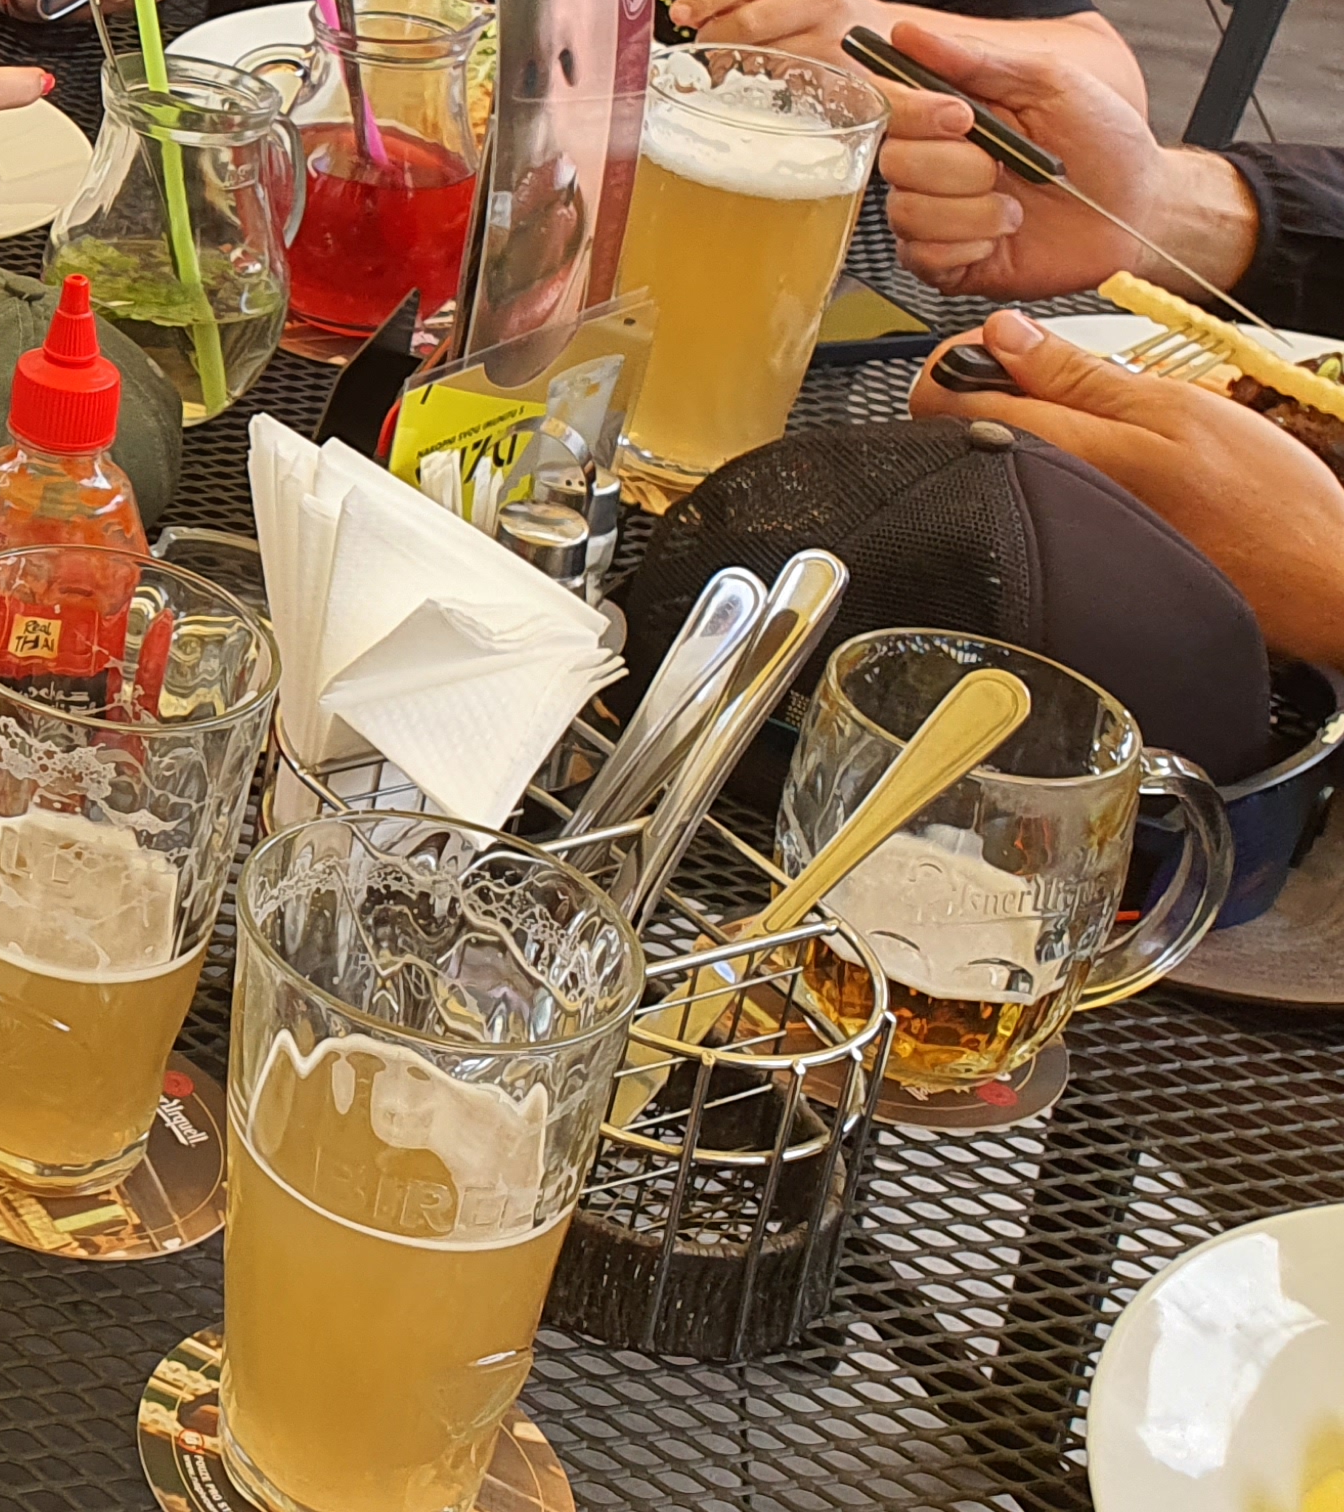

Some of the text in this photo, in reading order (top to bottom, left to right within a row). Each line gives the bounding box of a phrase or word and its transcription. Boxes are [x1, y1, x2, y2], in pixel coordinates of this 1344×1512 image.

[23, 619, 52, 636] Real
[14, 634, 55, 653] THAI
[159, 1098, 209, 1144] Urquell
[205, 1483, 223, 1501] PRO
